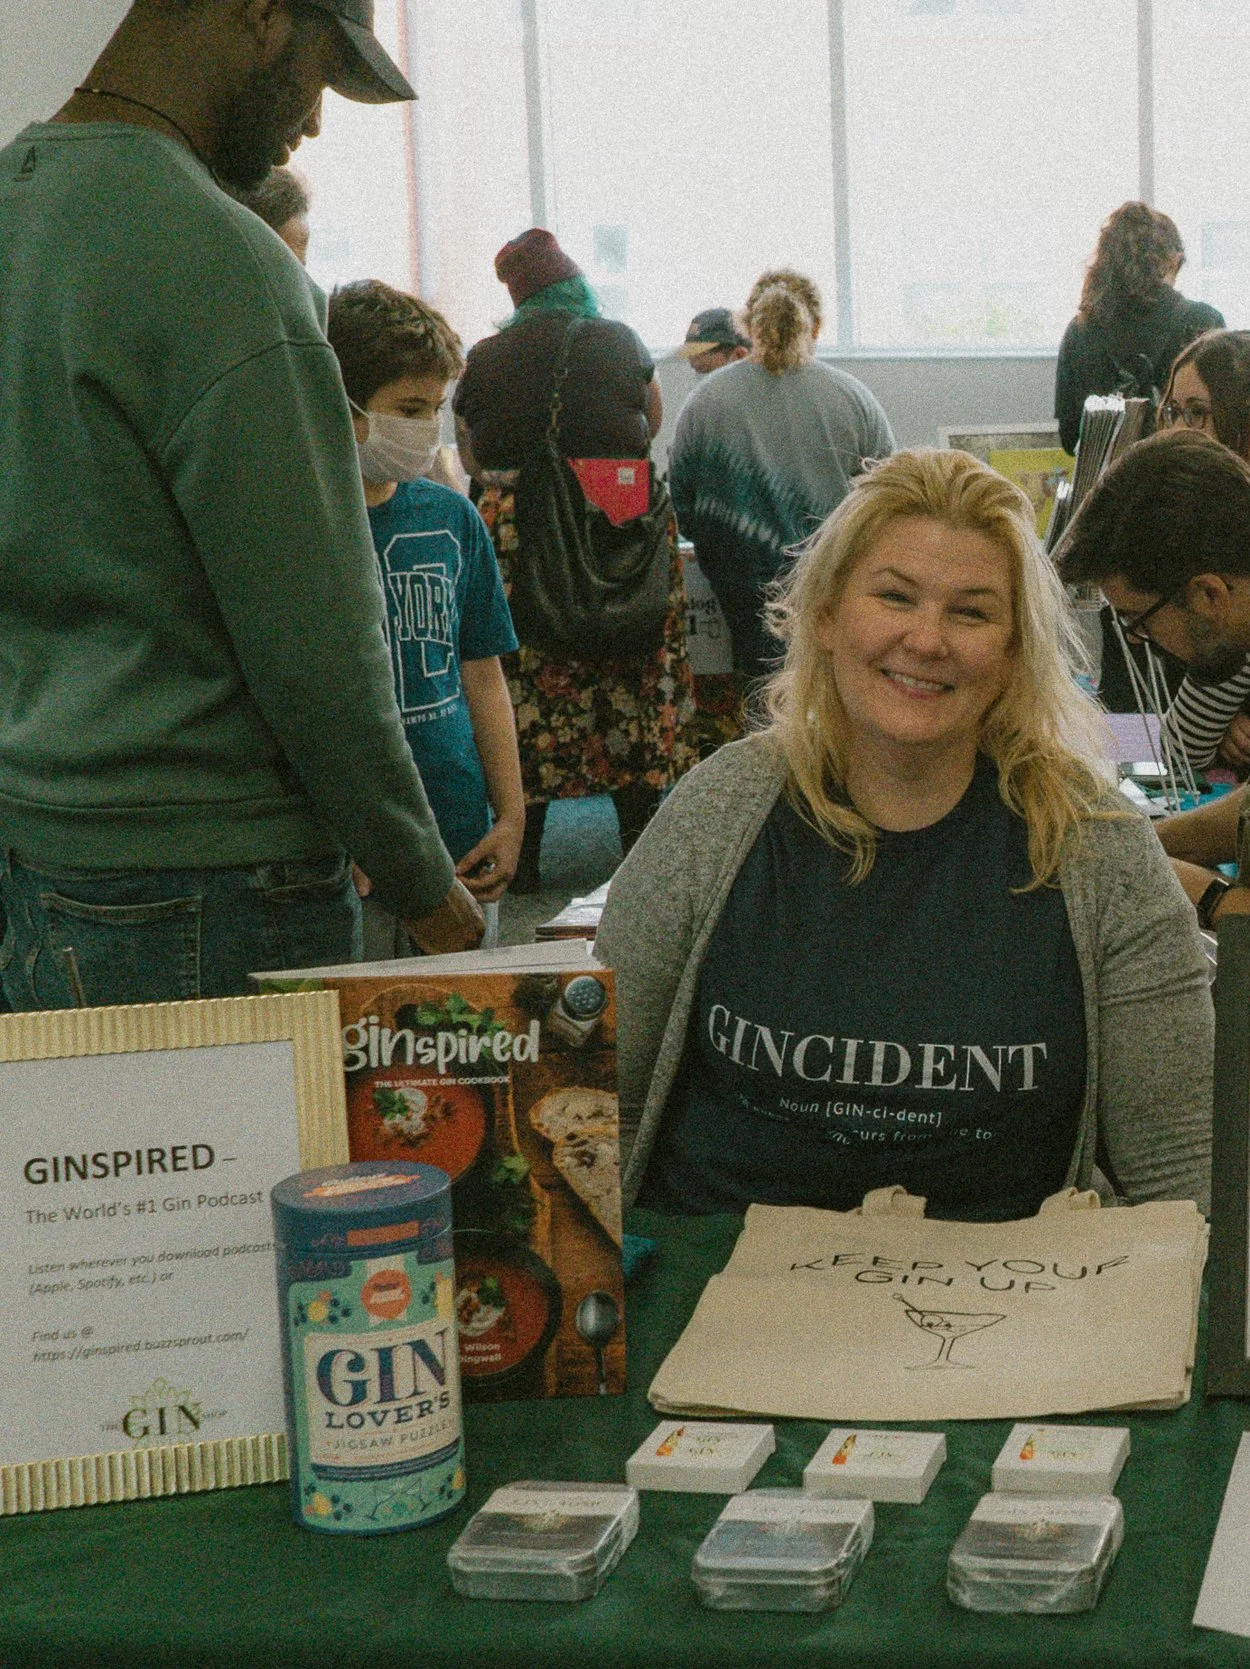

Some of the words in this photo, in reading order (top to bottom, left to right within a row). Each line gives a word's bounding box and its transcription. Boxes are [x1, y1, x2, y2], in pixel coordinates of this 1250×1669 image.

[708, 1004, 1048, 1092] GINCIDENT
[779, 1097, 819, 1113] Noun
[24, 1143, 215, 1184] GINSPIRED
[26, 1209, 58, 1224] The
[63, 1200, 131, 1221] World's
[136, 1200, 157, 1214] #1
[162, 1197, 192, 1212] Gin
[197, 1191, 264, 1209] Podcast
[28, 1262, 66, 1275] Listen
[69, 1257, 127, 1271] wherever
[131, 1253, 154, 1267] you
[158, 1247, 219, 1264] download
[790, 1253, 945, 1272] KEEP
[160, 1272, 173, 1283] or
[855, 1270, 954, 1287] GIN
[980, 1277, 1057, 1293] UP
[31, 1329, 58, 1342] Find
[63, 1331, 77, 1341] us
[316, 1327, 450, 1407] GIN
[122, 1402, 203, 1439] GIN
[324, 1390, 451, 1429] LOVER'S
[334, 1436, 393, 1450] JIGSAW
